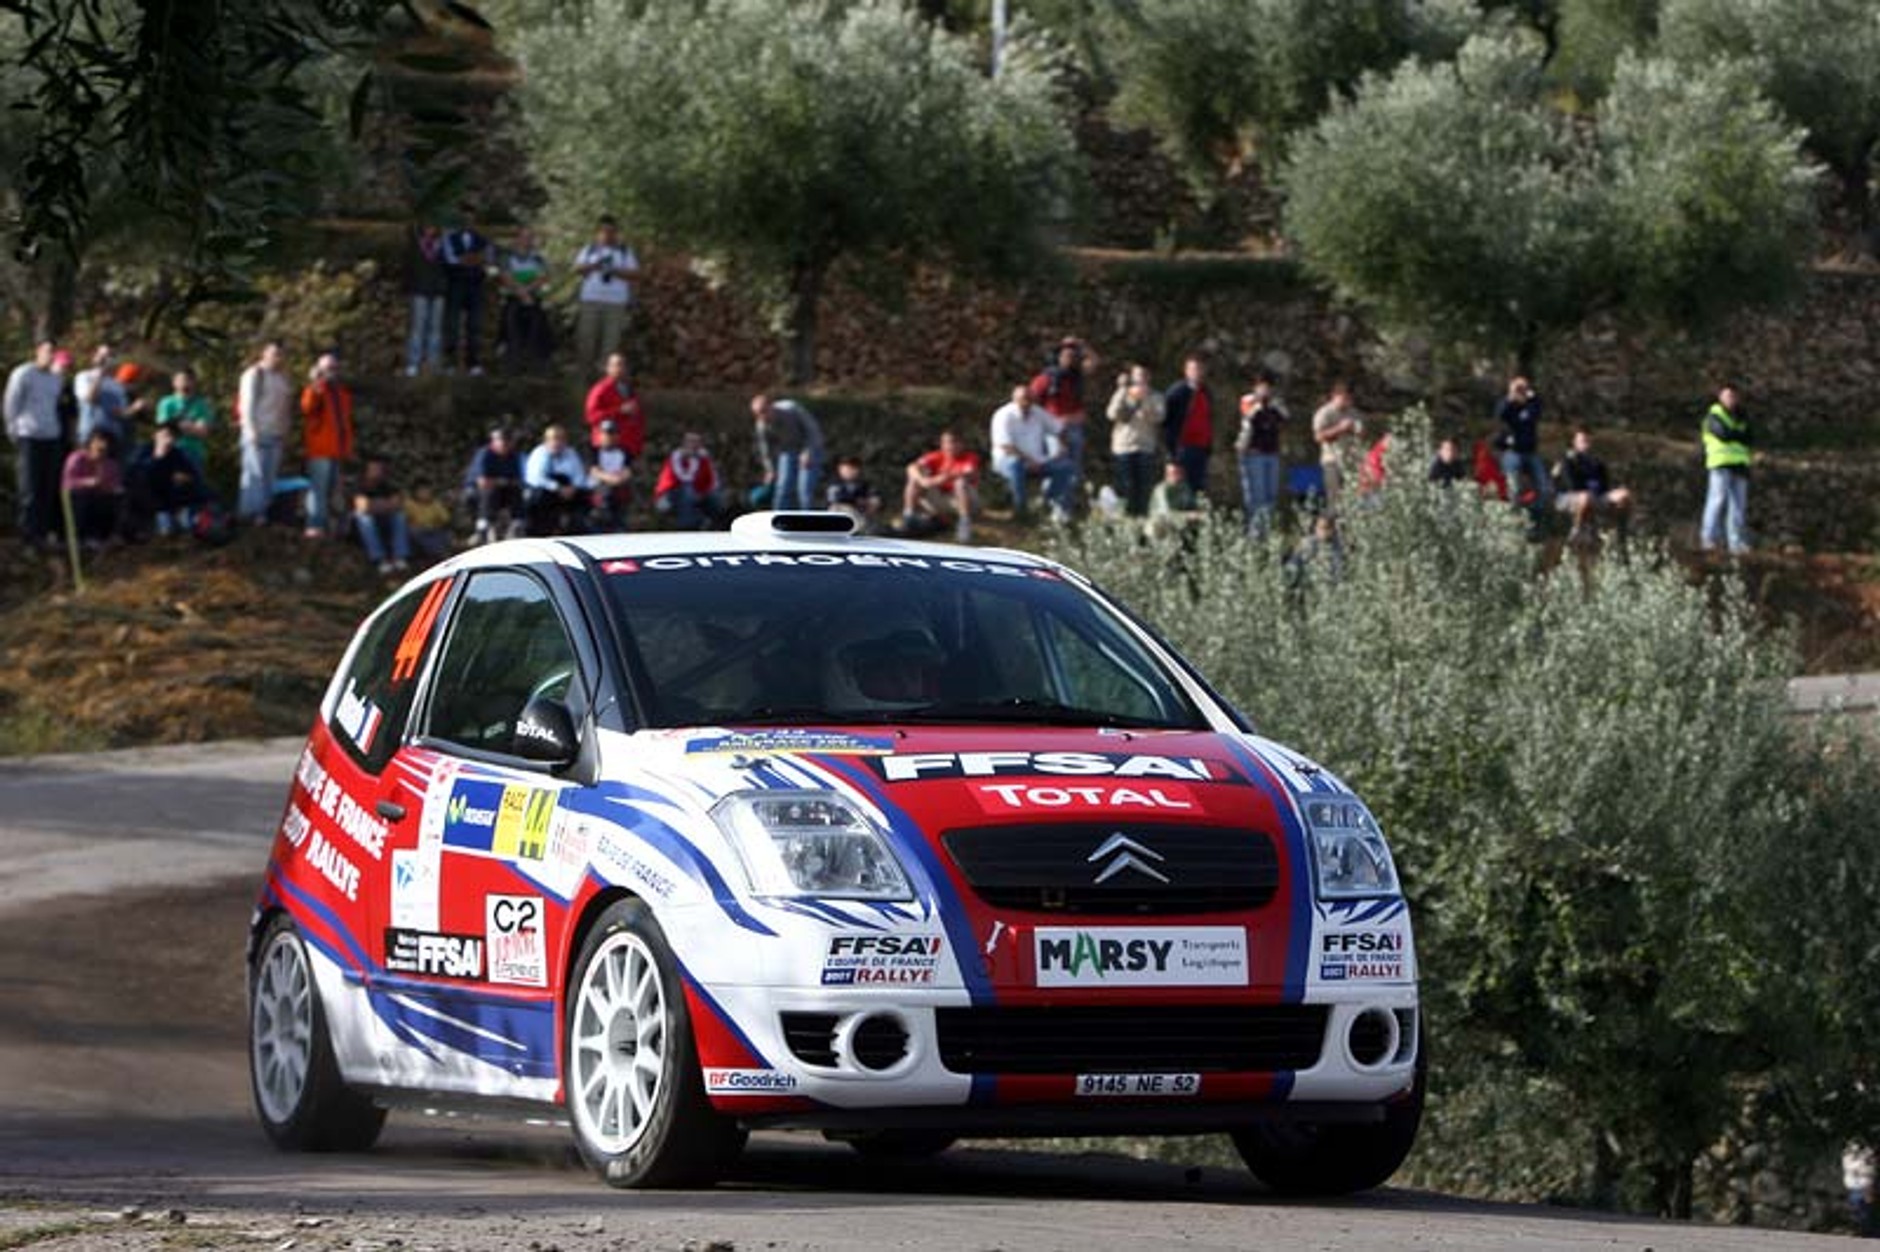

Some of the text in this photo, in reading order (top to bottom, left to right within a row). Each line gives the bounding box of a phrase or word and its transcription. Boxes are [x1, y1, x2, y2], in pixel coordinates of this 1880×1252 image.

[979, 784, 1192, 809] TOTAL
[304, 830, 361, 902] RALLYE
[494, 899, 537, 934] C2
[830, 937, 928, 955] FFSA
[1323, 933, 1395, 952] FFSA
[872, 958, 886, 967] DE
[891, 958, 936, 967] FRANCE
[1040, 932, 1174, 978] MARSY
[857, 969, 934, 983] RALLYE
[710, 1071, 797, 1087] BFGoodrich
[1083, 1075, 1195, 1093] 9145 NE 52
